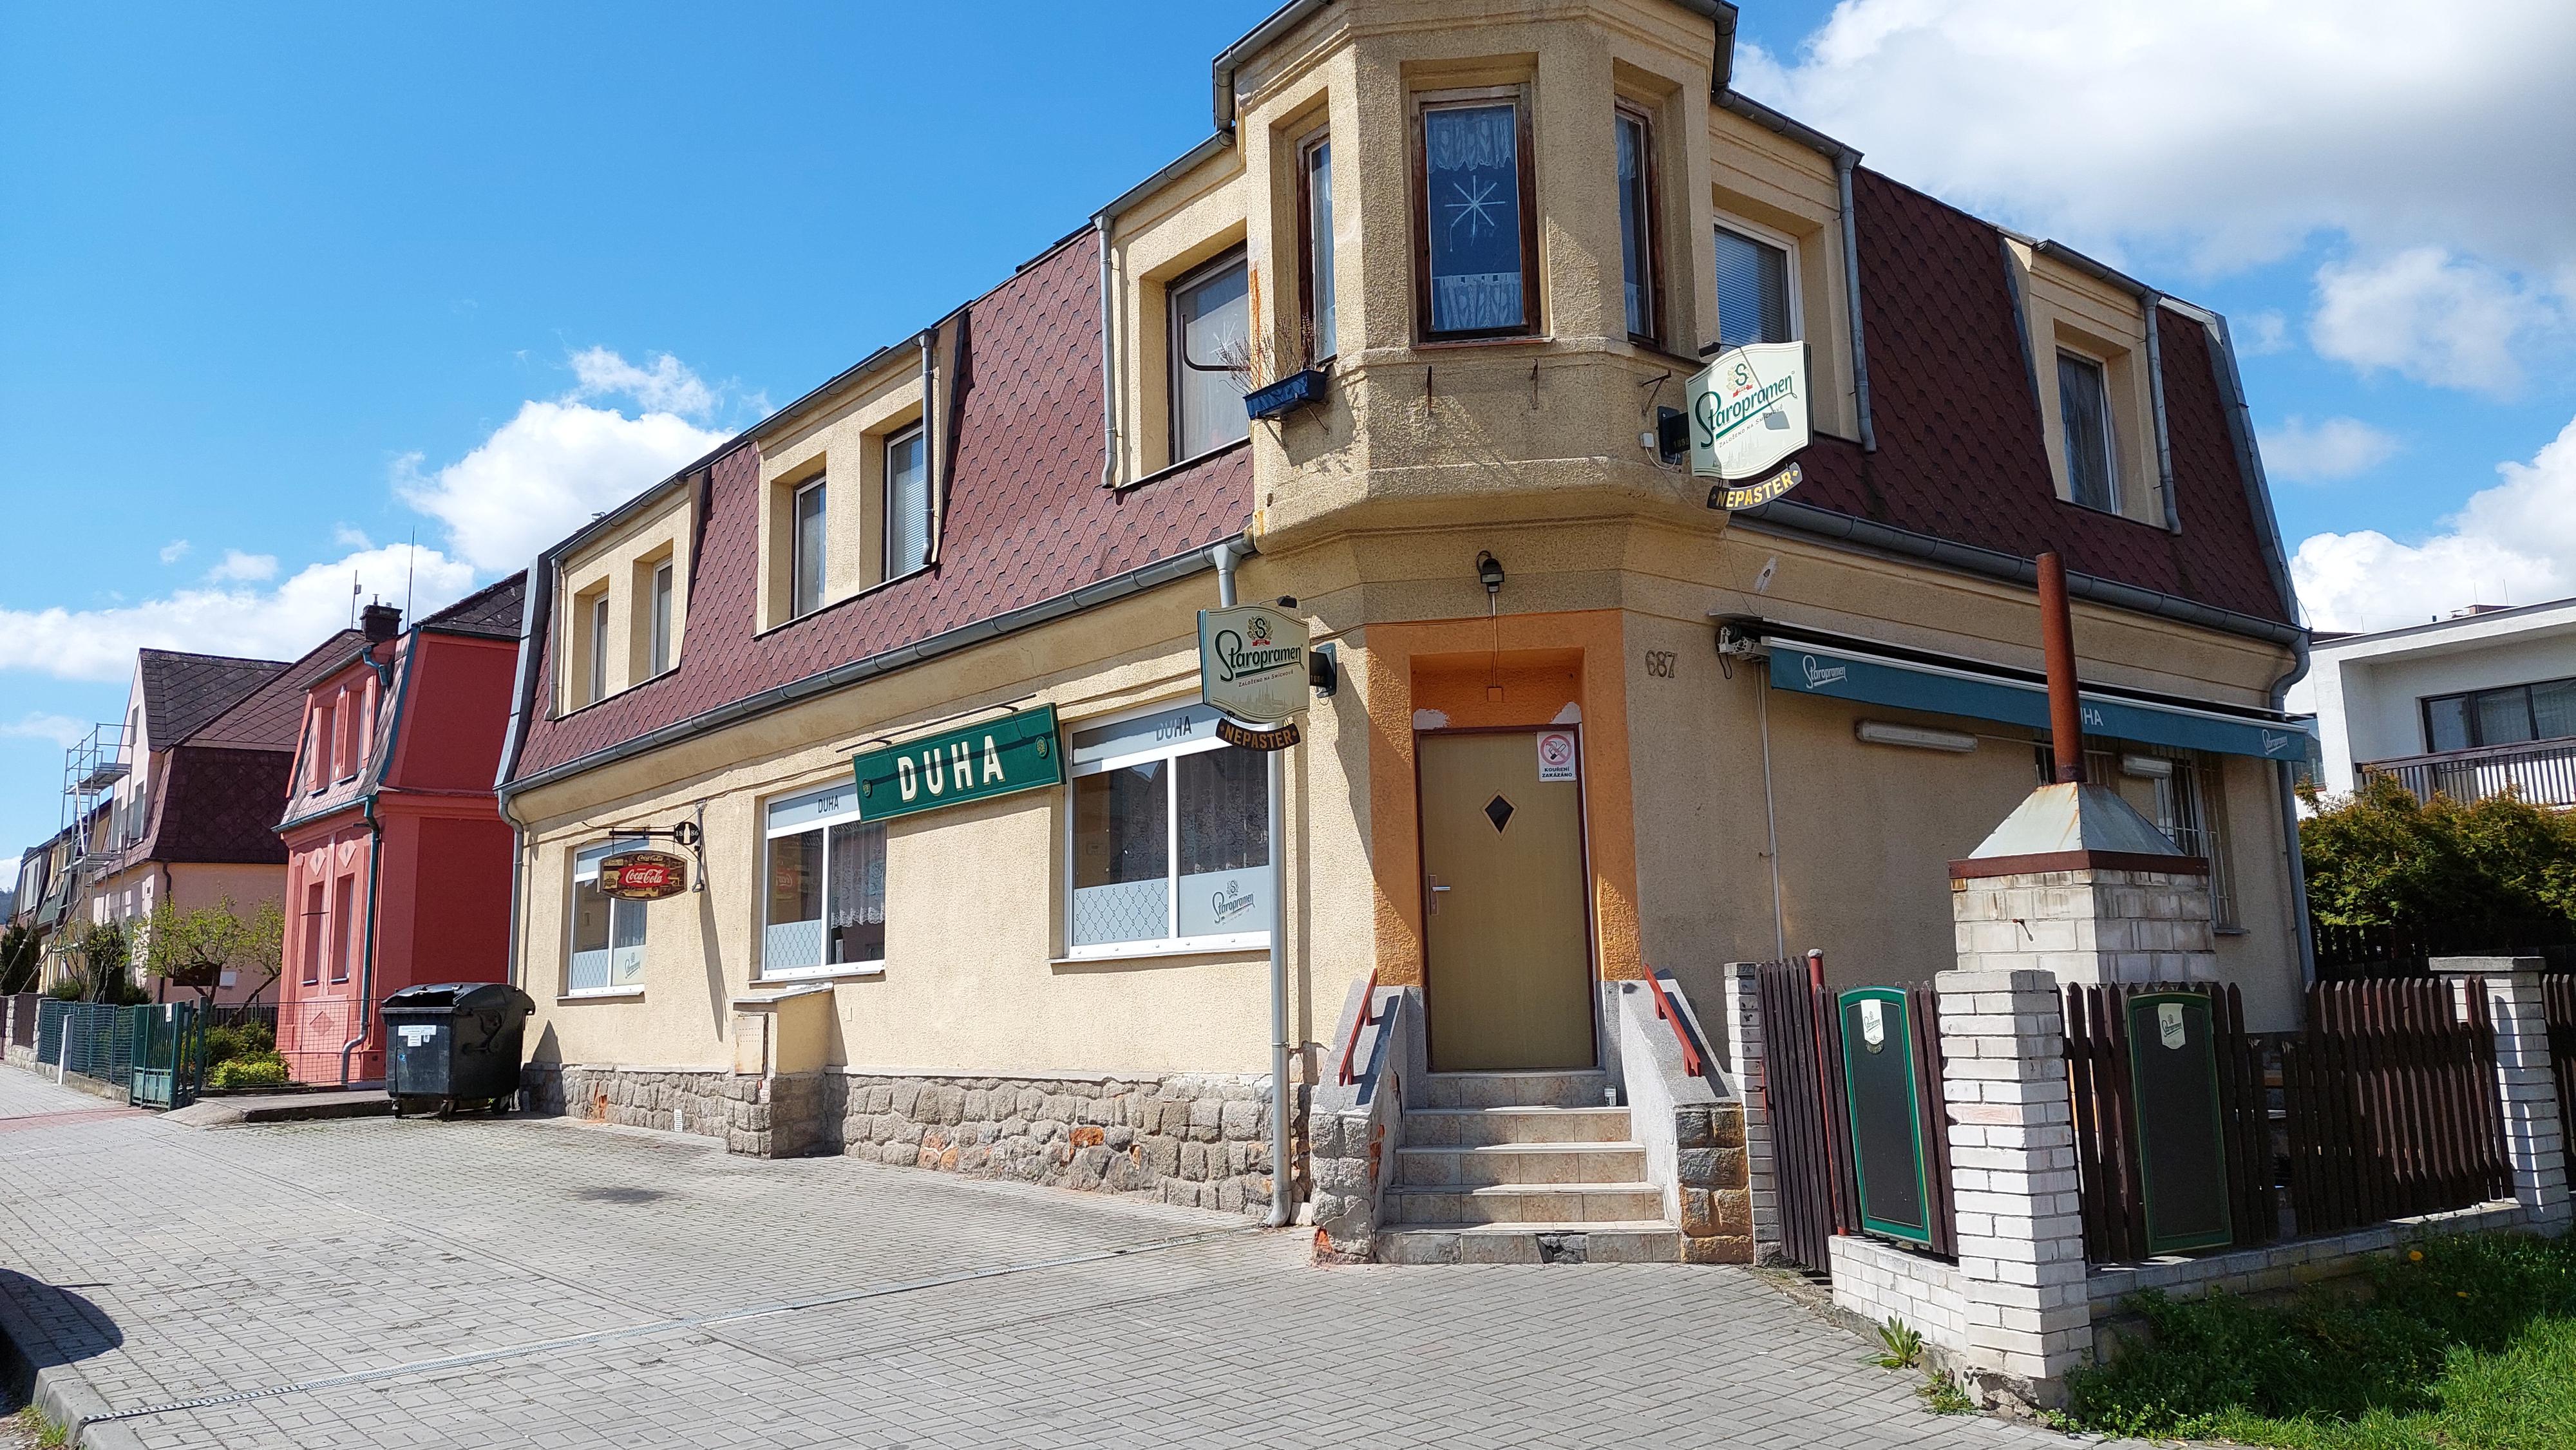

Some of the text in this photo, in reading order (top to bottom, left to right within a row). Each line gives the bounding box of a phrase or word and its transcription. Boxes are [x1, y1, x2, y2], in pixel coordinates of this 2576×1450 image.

[1734, 362, 1749, 386] S
[1695, 375, 1797, 449] Staropramen
[1716, 471, 1794, 507] NEPASTER
[1255, 617, 1267, 639] S
[1215, 629, 1305, 682] Staropramen
[1645, 650, 1678, 679] 687
[1803, 655, 1848, 689] Staropramen
[1156, 715, 1192, 742] DUHA
[2079, 707, 2104, 726] HA
[1224, 724, 1294, 749] NEPASTER
[897, 735, 1005, 803] DUHA
[817, 795, 839, 813] DUHA
[1212, 891, 1255, 924] Staropramen
